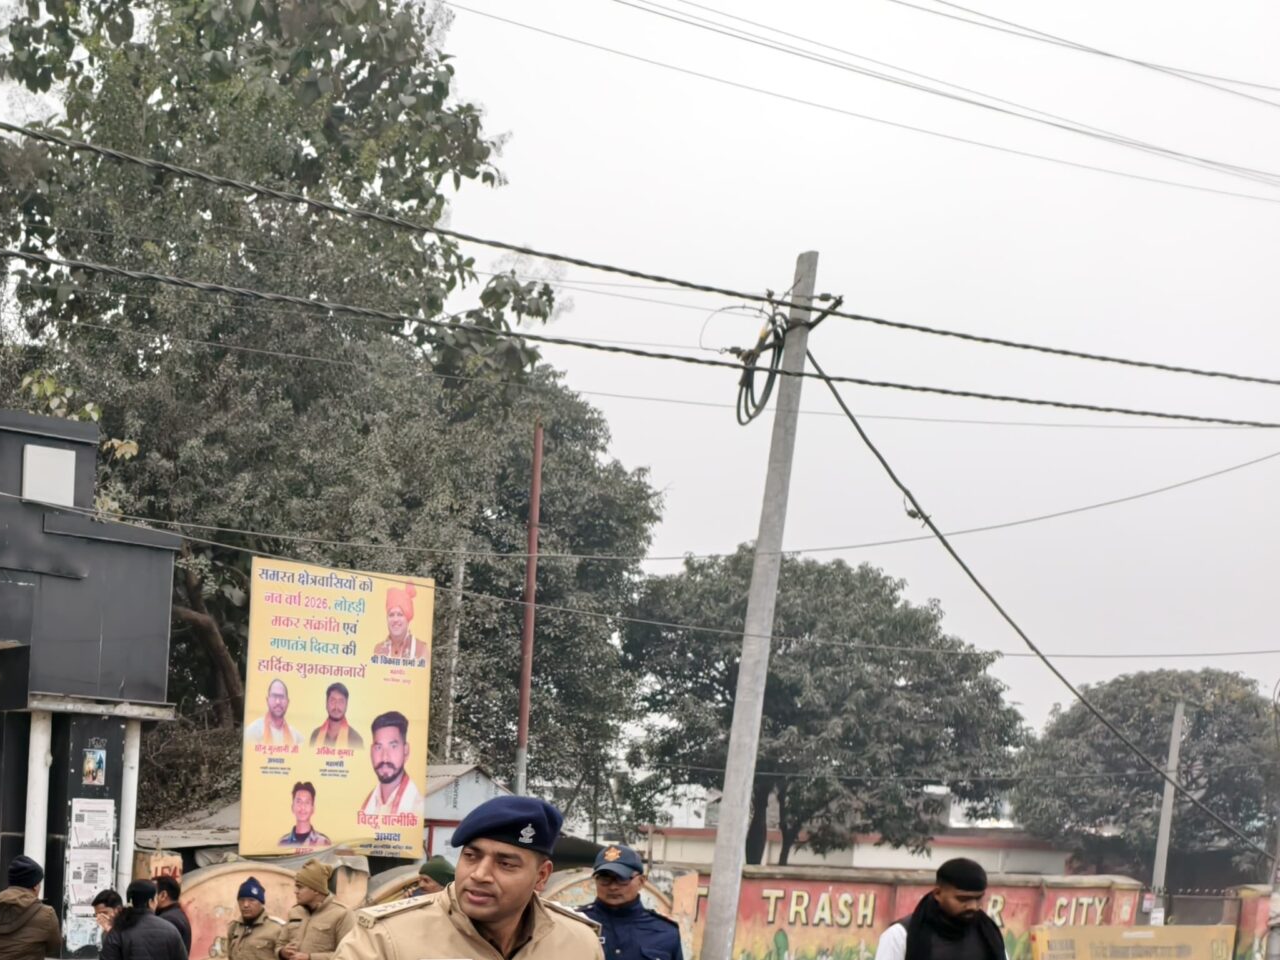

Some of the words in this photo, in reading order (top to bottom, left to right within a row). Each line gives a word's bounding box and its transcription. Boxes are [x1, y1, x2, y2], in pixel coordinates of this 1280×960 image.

[259, 568, 295, 583] समस्त
[359, 577, 373, 592] को
[264, 592, 282, 604] नव
[285, 590, 301, 606] वर्ष
[272, 616, 300, 628] मकर
[342, 620, 359, 635] एवं
[310, 637, 339, 654] दिवस
[342, 641, 357, 656] की
[258, 656, 293, 672] हार्दिक
[762, 887, 876, 926] TRASH
[1054, 896, 1108, 926] CITY
